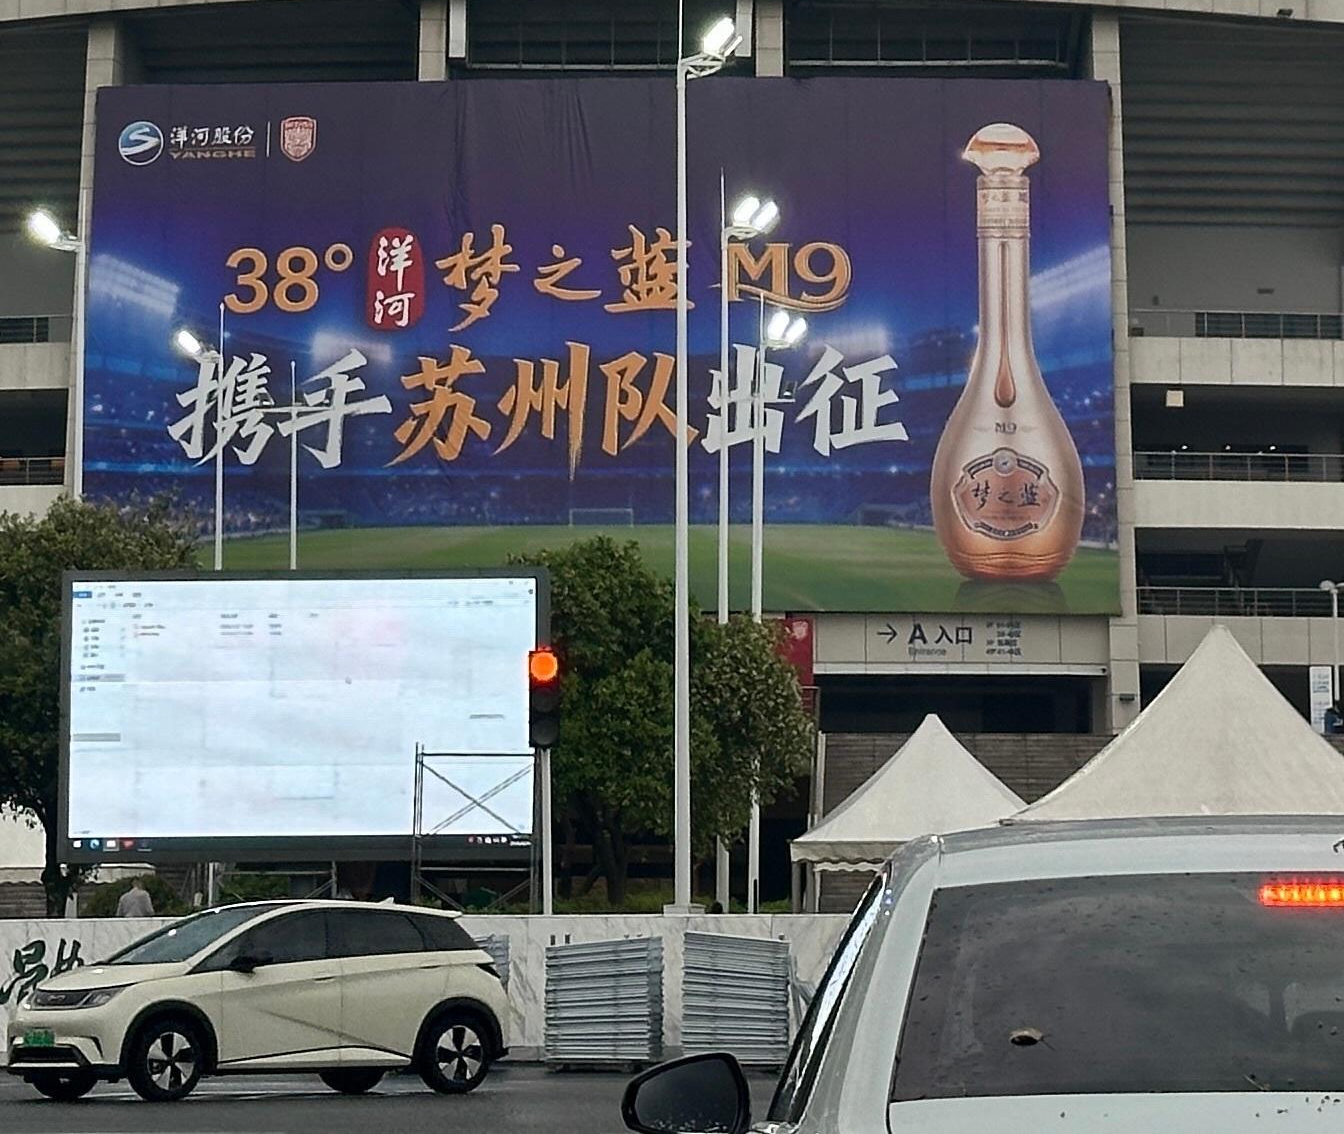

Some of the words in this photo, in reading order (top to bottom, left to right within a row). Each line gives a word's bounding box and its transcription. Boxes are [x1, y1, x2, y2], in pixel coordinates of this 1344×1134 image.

[169, 125, 255, 149] 洋河股份
[169, 148, 256, 159] YANGHE
[374, 233, 415, 328] 洋河
[435, 223, 696, 333] 梦之蓝
[710, 241, 852, 313] M9
[166, 342, 908, 481] 携手苏州队出征
[971, 480, 1041, 511] 梦之蓝
